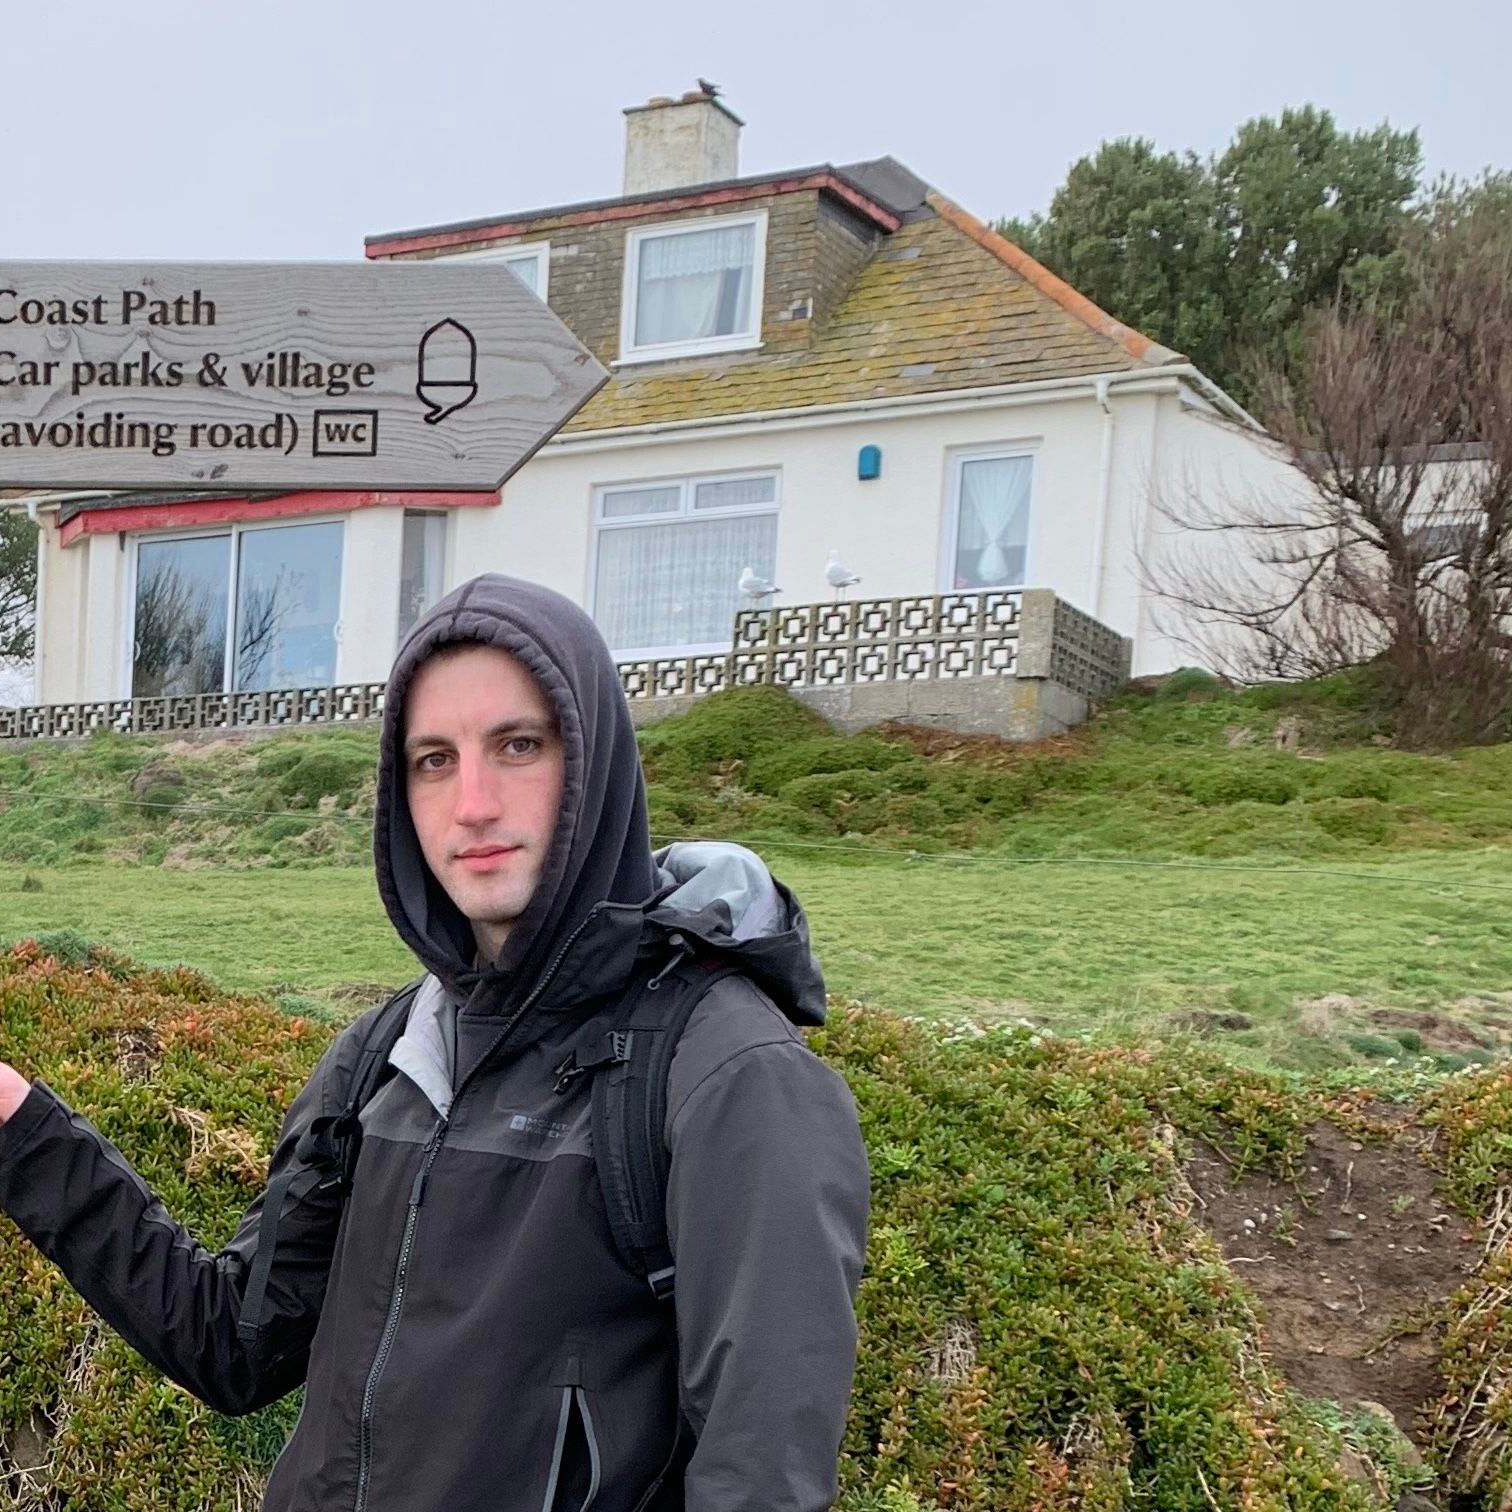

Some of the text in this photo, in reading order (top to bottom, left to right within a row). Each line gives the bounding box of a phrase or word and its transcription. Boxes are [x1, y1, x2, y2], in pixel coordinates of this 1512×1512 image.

[121, 289, 216, 326] Path
[71, 351, 184, 396] parks
[195, 352, 228, 388] &
[240, 351, 376, 397] village
[189, 412, 299, 456] road)
